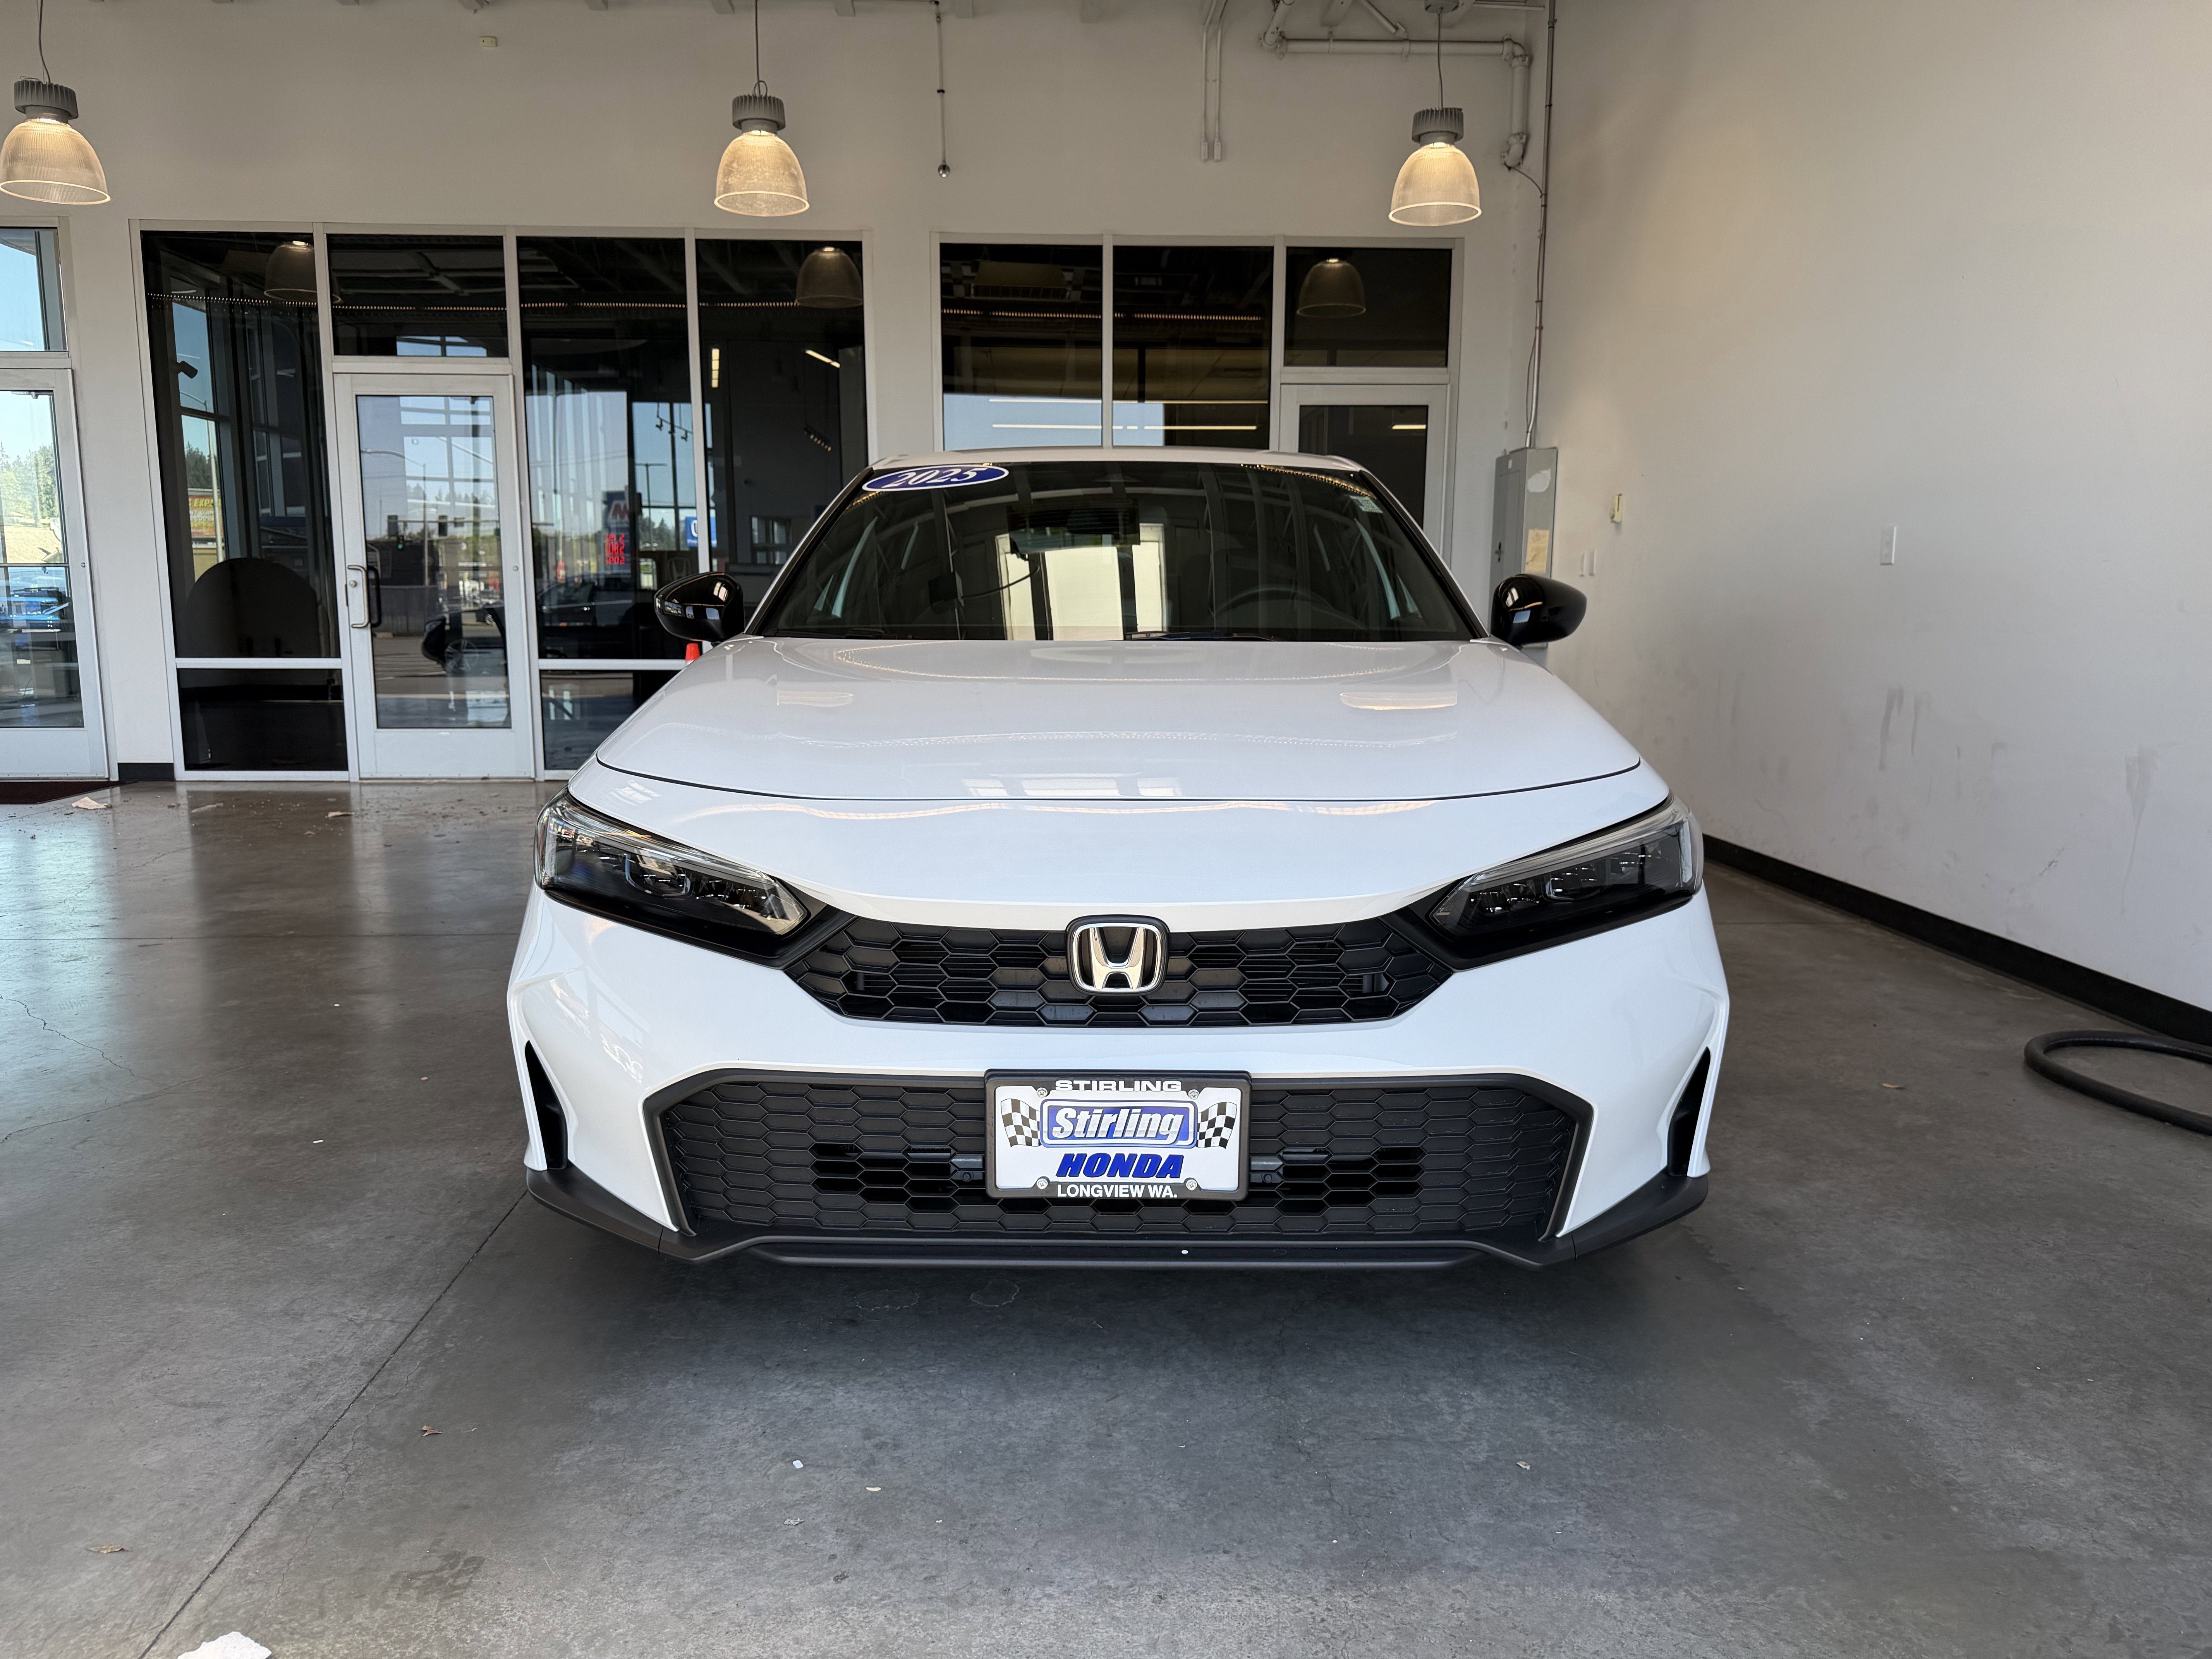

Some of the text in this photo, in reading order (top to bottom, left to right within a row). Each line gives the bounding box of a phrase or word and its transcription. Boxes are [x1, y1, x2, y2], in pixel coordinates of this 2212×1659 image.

[881, 467, 988, 488] 2025
[1055, 1080, 1182, 1092] STIRLING
[1052, 1108, 1184, 1139] Stirling
[1056, 1152, 1184, 1178] HONDA
[1057, 1185, 1178, 1198] LONGVIEW WA.
